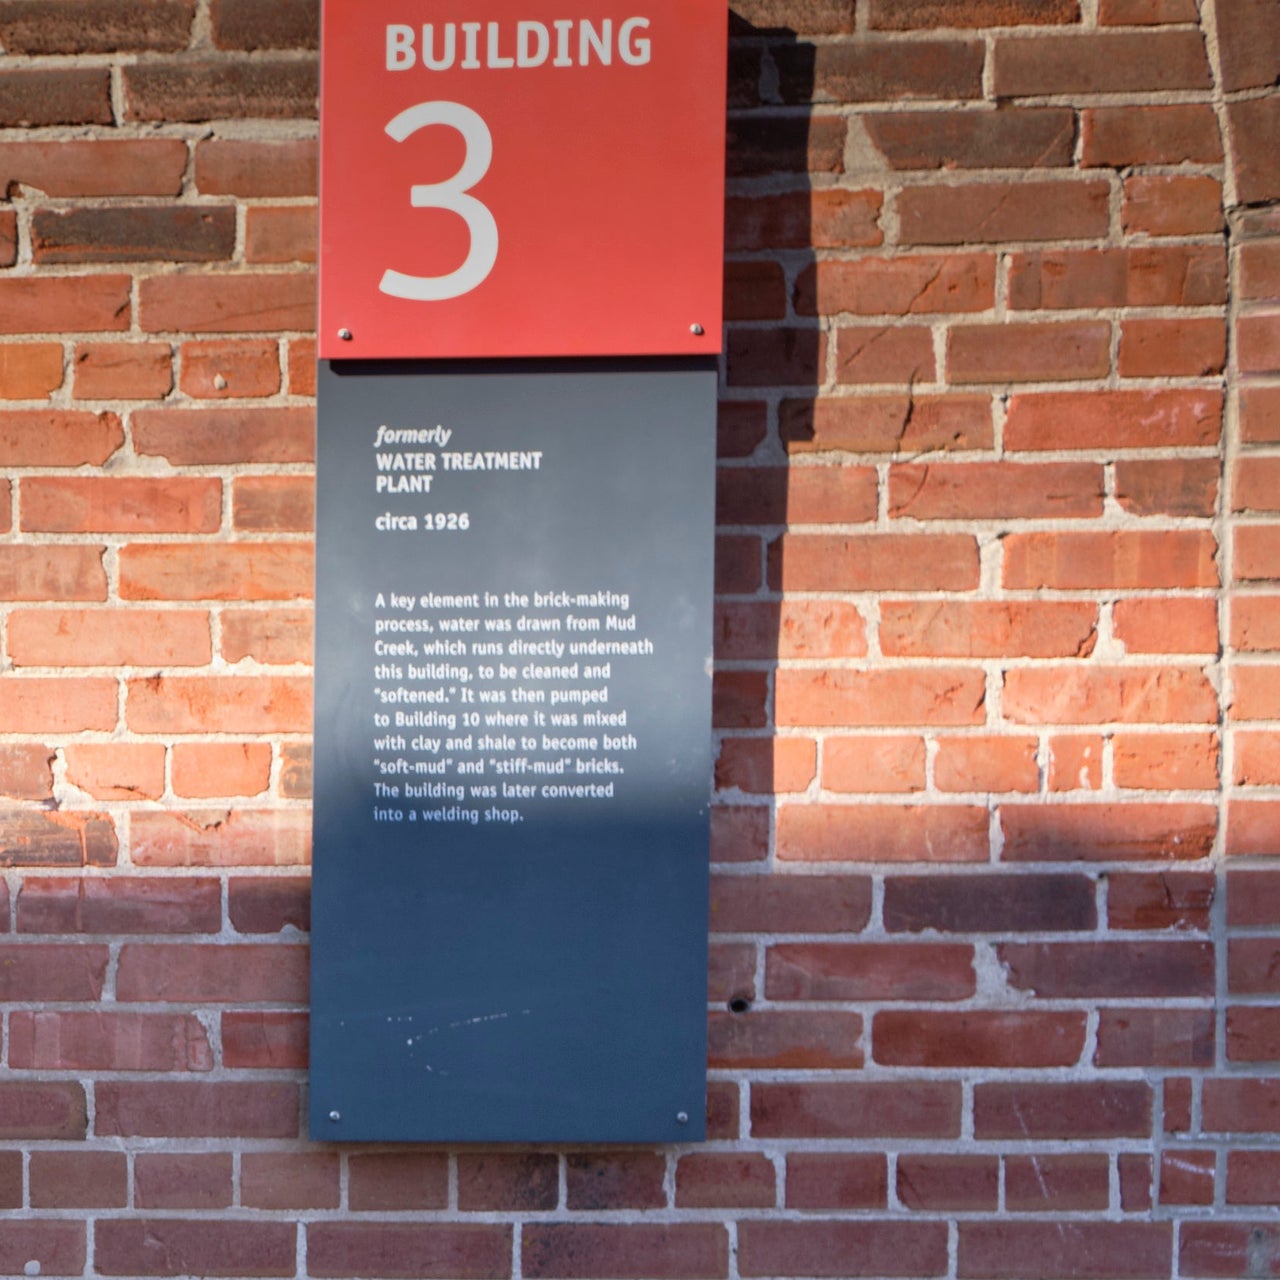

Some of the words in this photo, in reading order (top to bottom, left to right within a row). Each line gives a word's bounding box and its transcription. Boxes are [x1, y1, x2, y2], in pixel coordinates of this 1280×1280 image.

[385, 16, 652, 72] BUILDING
[378, 100, 500, 302] 3
[373, 424, 453, 447] formerly
[375, 452, 437, 472] WATER
[440, 450, 544, 471] TREATMENT
[375, 474, 434, 494] PLANT
[374, 511, 418, 531] circa
[423, 512, 470, 531] 1926
[374, 592, 386, 609] A
[390, 591, 417, 612] key
[419, 591, 480, 609] element
[483, 591, 499, 608] in
[503, 591, 530, 608] the
[533, 590, 630, 611] brick-making
[374, 619, 434, 636] process,
[438, 617, 480, 632] water
[484, 618, 512, 632] was
[516, 615, 561, 632] drawn
[566, 614, 600, 632] from
[605, 613, 636, 631] Mud
[374, 639, 419, 658] Creek,
[423, 639, 467, 656] which
[471, 642, 504, 656] runs
[508, 638, 565, 659] directly
[569, 637, 654, 656] underneath
[373, 663, 403, 680] this
[407, 662, 474, 683] building,
[477, 664, 495, 680] to
[498, 662, 518, 680] be
[521, 662, 579, 680] cleaned
[583, 661, 611, 679] and
[460, 686, 475, 704] It
[478, 690, 507, 704] was
[510, 686, 545, 703] then
[550, 685, 609, 706] pumped
[373, 712, 391, 728] to
[395, 710, 457, 731] Building
[462, 711, 481, 727] 10
[484, 710, 529, 727] where
[533, 710, 546, 727] it
[550, 713, 578, 727] was
[583, 709, 627, 727] mixed
[373, 734, 406, 751] with
[411, 734, 441, 754] clay
[445, 734, 473, 751] and
[477, 734, 517, 751] shale
[520, 735, 537, 751] to
[542, 734, 598, 751] become
[602, 733, 638, 751] both
[457, 757, 485, 775] and
[575, 757, 625, 774] bricks.
[373, 782, 400, 798] The
[404, 782, 465, 801] building
[470, 785, 497, 798] was
[502, 781, 537, 798] later
[541, 781, 614, 799] converted
[373, 805, 404, 822] into
[408, 809, 417, 822] a
[422, 805, 479, 825] welding
[484, 805, 524, 825] shop.
